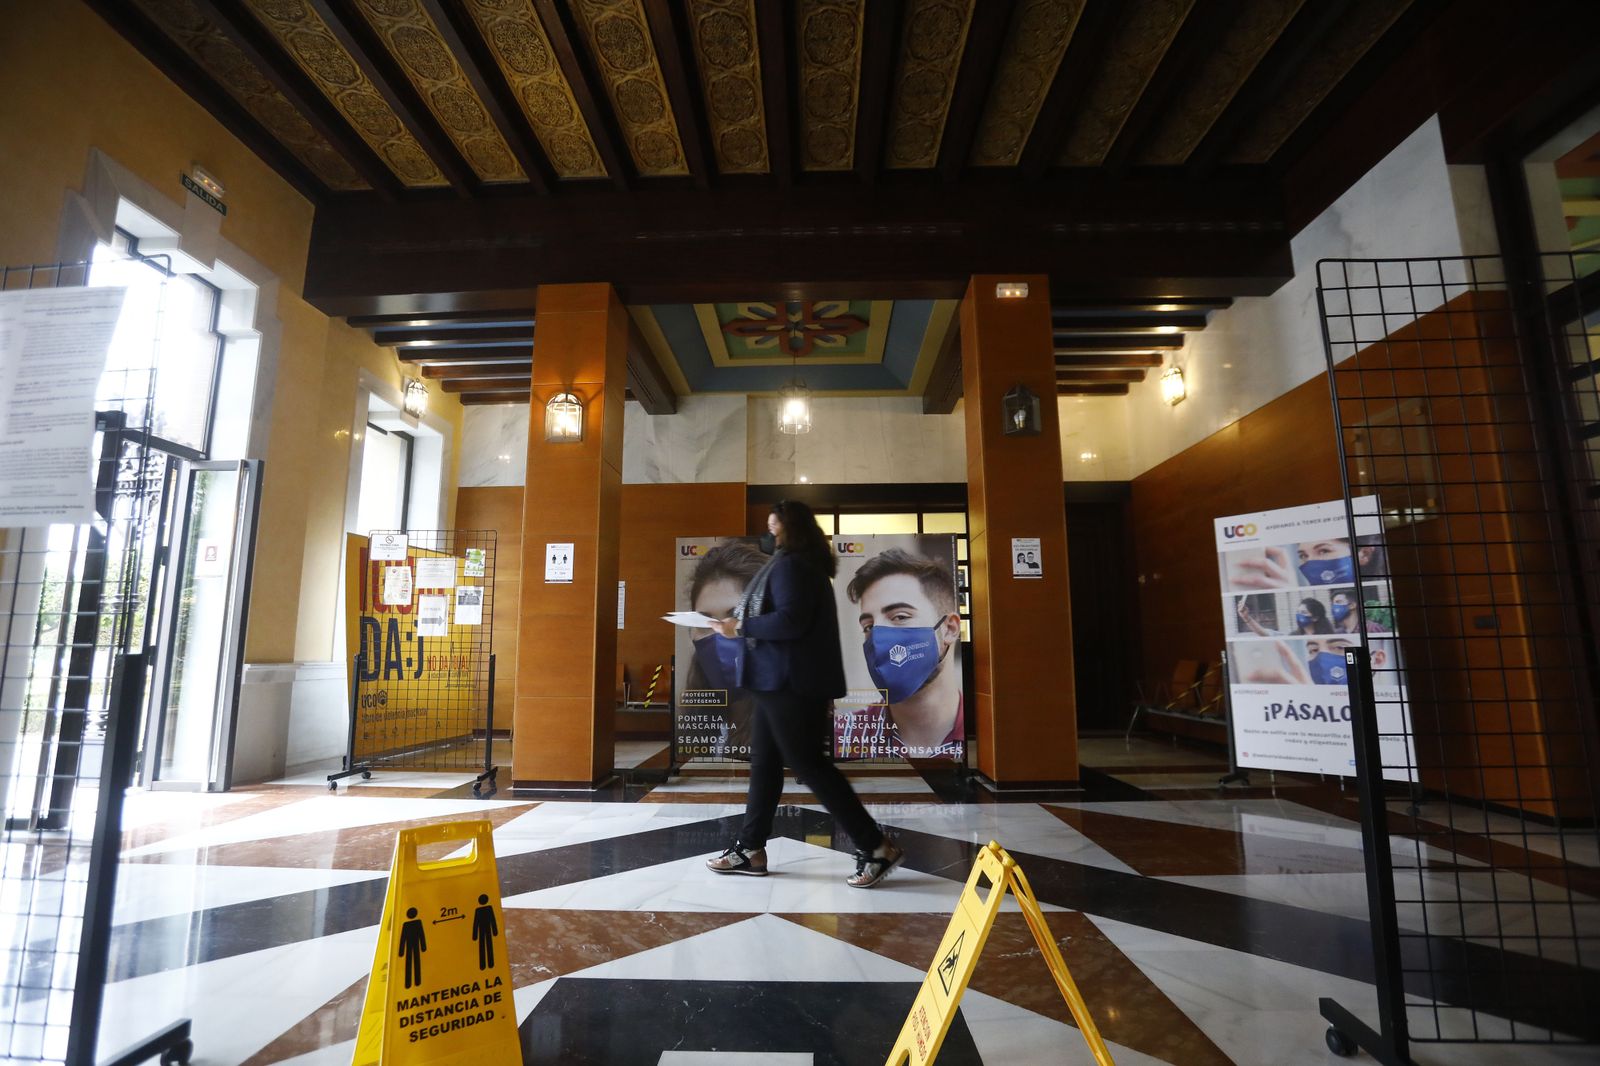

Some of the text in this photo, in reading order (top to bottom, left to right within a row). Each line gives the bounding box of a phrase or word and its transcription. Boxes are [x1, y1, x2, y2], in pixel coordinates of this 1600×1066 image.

[185, 177, 225, 214] SALIDA
[1224, 523, 1257, 538] UCO
[837, 542, 865, 554] UCO
[837, 714, 884, 722] PONTE LA
[837, 722, 898, 730] MASCARILLA
[678, 736, 726, 744] SEAMOS
[838, 735, 886, 744] SEAMOS
[838, 745, 964, 755] #UCORESPONSABLES
[440, 907, 458, 918] 2m
[397, 976, 503, 1012] MANTENGA LA
[400, 991, 502, 1029] DISTANCIA DE
[409, 1010, 495, 1043] SEGURIDAD
